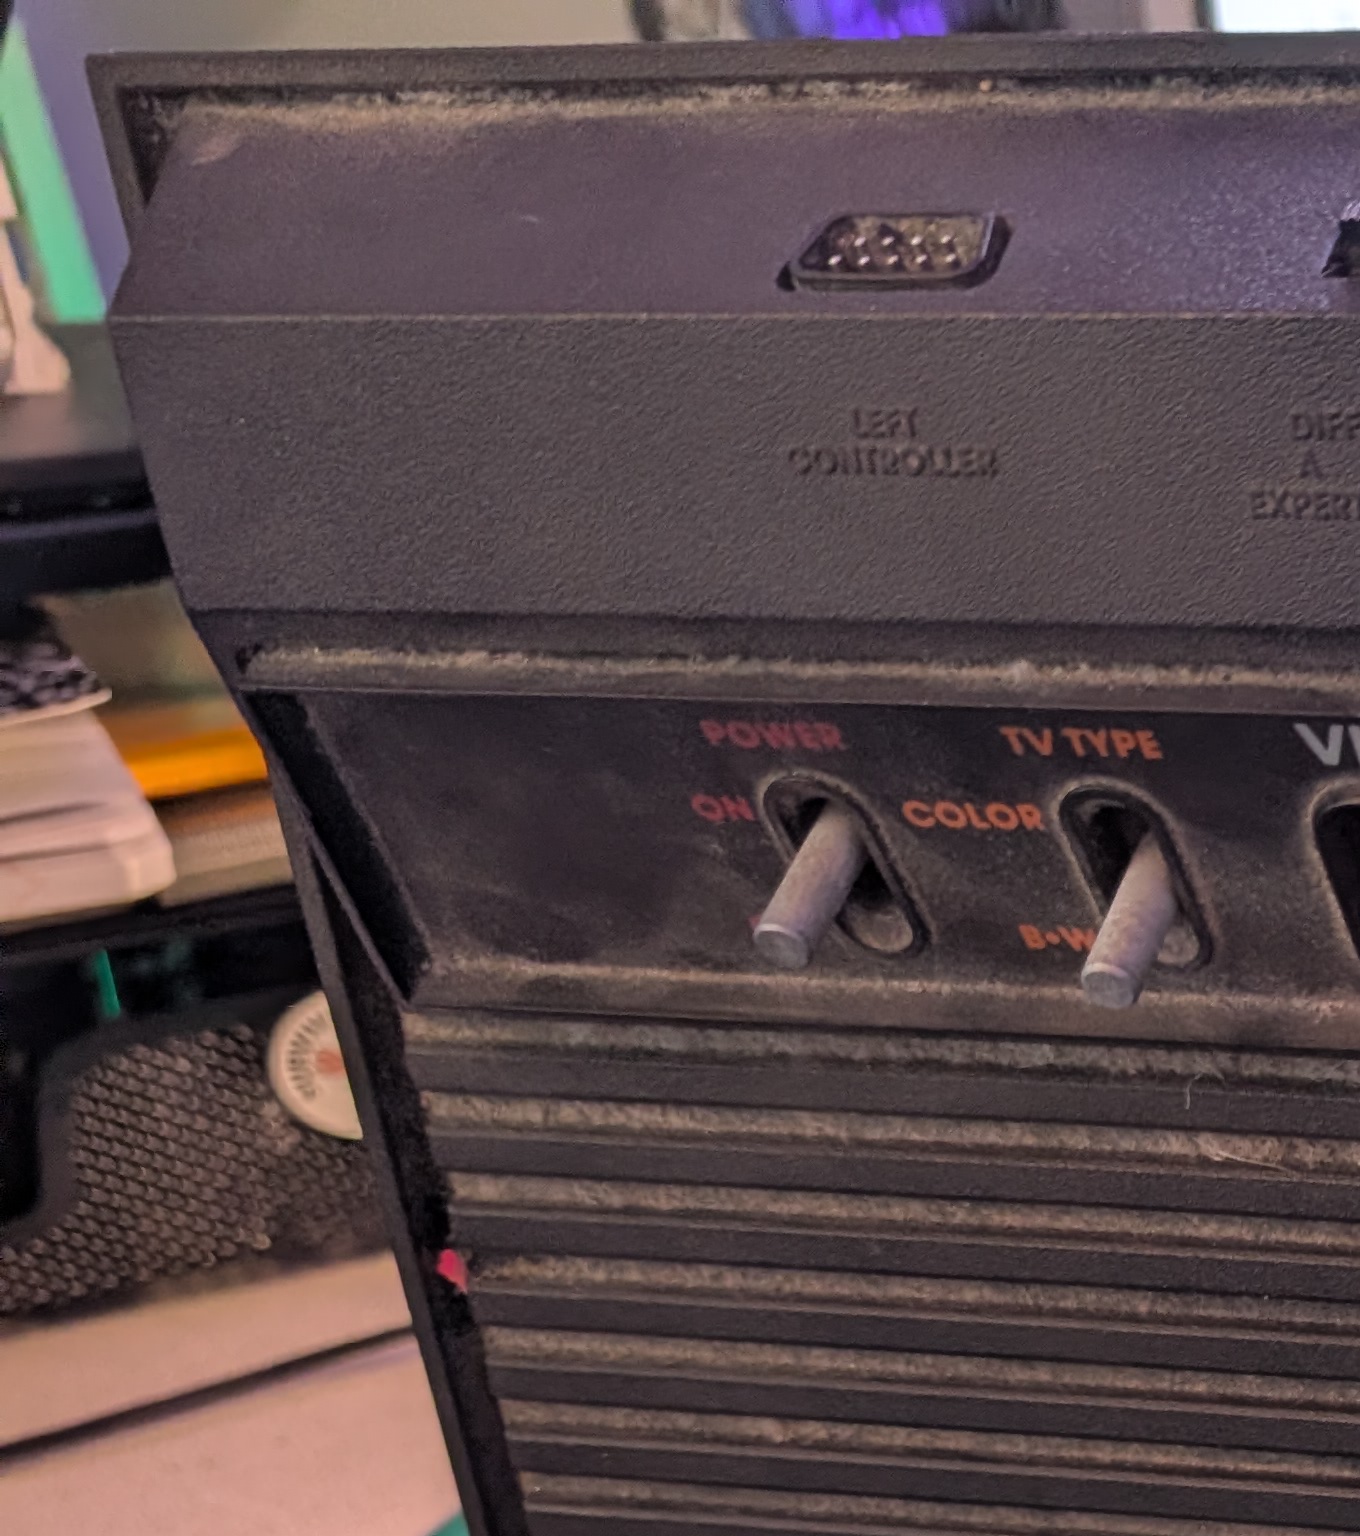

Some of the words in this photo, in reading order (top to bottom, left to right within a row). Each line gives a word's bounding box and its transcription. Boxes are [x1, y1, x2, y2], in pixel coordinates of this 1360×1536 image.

[853, 407, 918, 439] LEFT
[788, 448, 998, 477] CONTROLLER
[1300, 450, 1323, 480] A
[700, 720, 848, 752] POWER
[1000, 726, 1054, 757] TV
[1060, 727, 1164, 761] TYPE
[691, 794, 757, 824] ON
[902, 799, 1046, 831] COLOR
